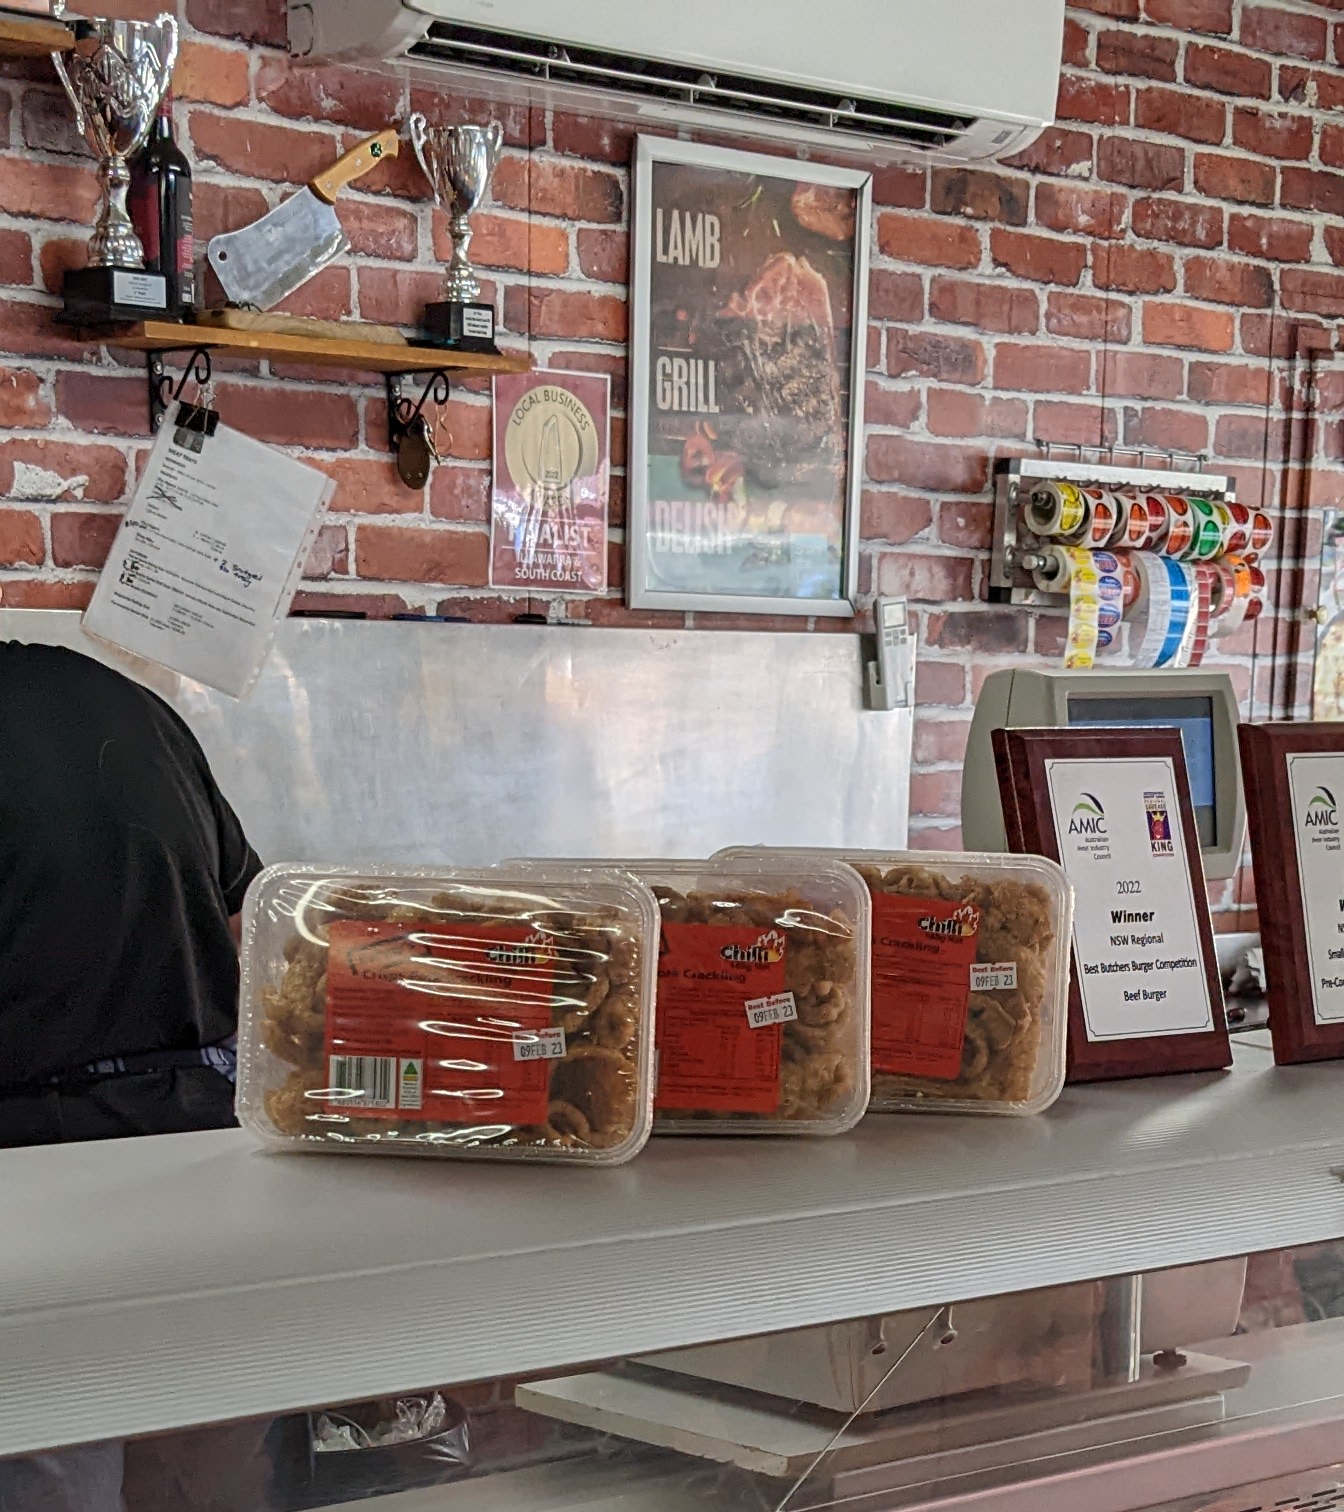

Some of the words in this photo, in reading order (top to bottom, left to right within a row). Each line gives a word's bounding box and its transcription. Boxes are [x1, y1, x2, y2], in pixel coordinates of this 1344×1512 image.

[656, 209, 721, 269] LAMB
[656, 356, 721, 413] GRILL
[513, 391, 541, 426] LOCAL
[544, 389, 590, 432] BUSINESS
[1305, 809, 1339, 827] AMIC
[1069, 818, 1107, 834] AMIC
[1151, 840, 1174, 852] KING
[1116, 880, 1141, 894] 2022
[1111, 910, 1155, 924] Winner
[1110, 935, 1129, 947] NSW
[1131, 932, 1164, 946] Regional
[1084, 963, 1100, 975] Best
[1101, 962, 1130, 974] Butchers
[1132, 960, 1154, 974] Burger
[1155, 957, 1198, 971] Competition
[1004, 975, 1013, 986] 23
[1123, 990, 1141, 1002] Beef
[1142, 988, 1167, 1002] Burger
[783, 1005, 794, 1017] 23
[551, 1042, 563, 1055] 23
